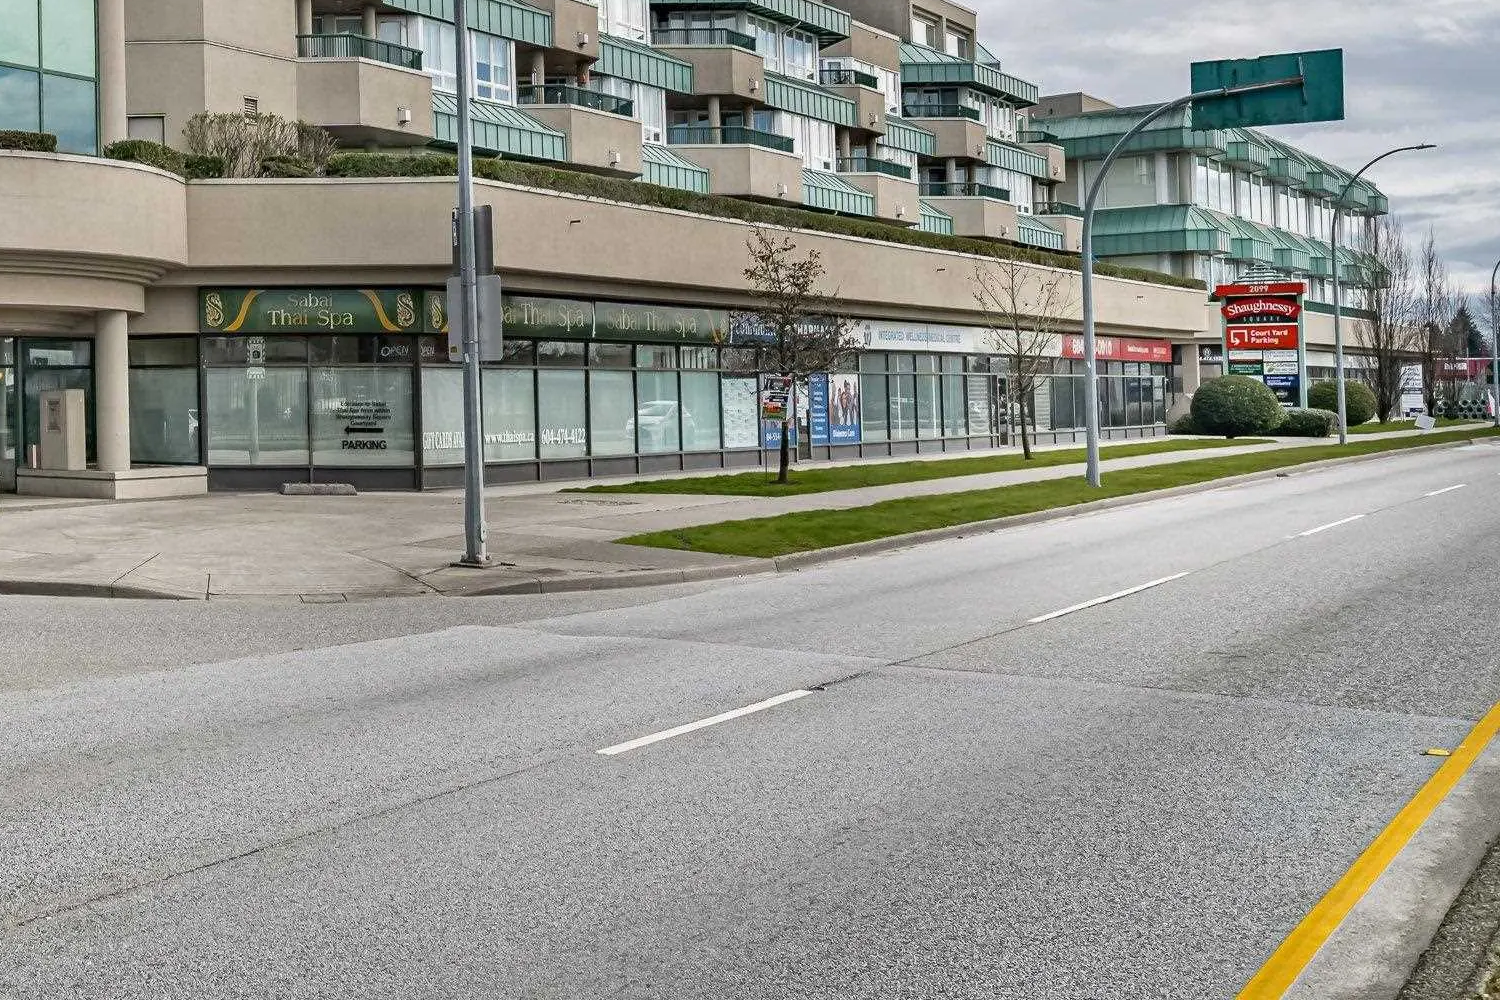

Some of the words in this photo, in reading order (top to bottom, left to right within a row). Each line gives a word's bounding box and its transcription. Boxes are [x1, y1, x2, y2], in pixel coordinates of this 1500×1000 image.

[1249, 285, 1269, 293] 2099
[287, 293, 333, 307] Sabai
[1227, 300, 1296, 316] Shaughnessy
[267, 310, 309, 326] Thai
[317, 310, 354, 329] Spa
[520, 303, 553, 325] Thai
[558, 304, 586, 331] Spa
[675, 313, 697, 338] Spa
[342, 440, 387, 450] PARKING
